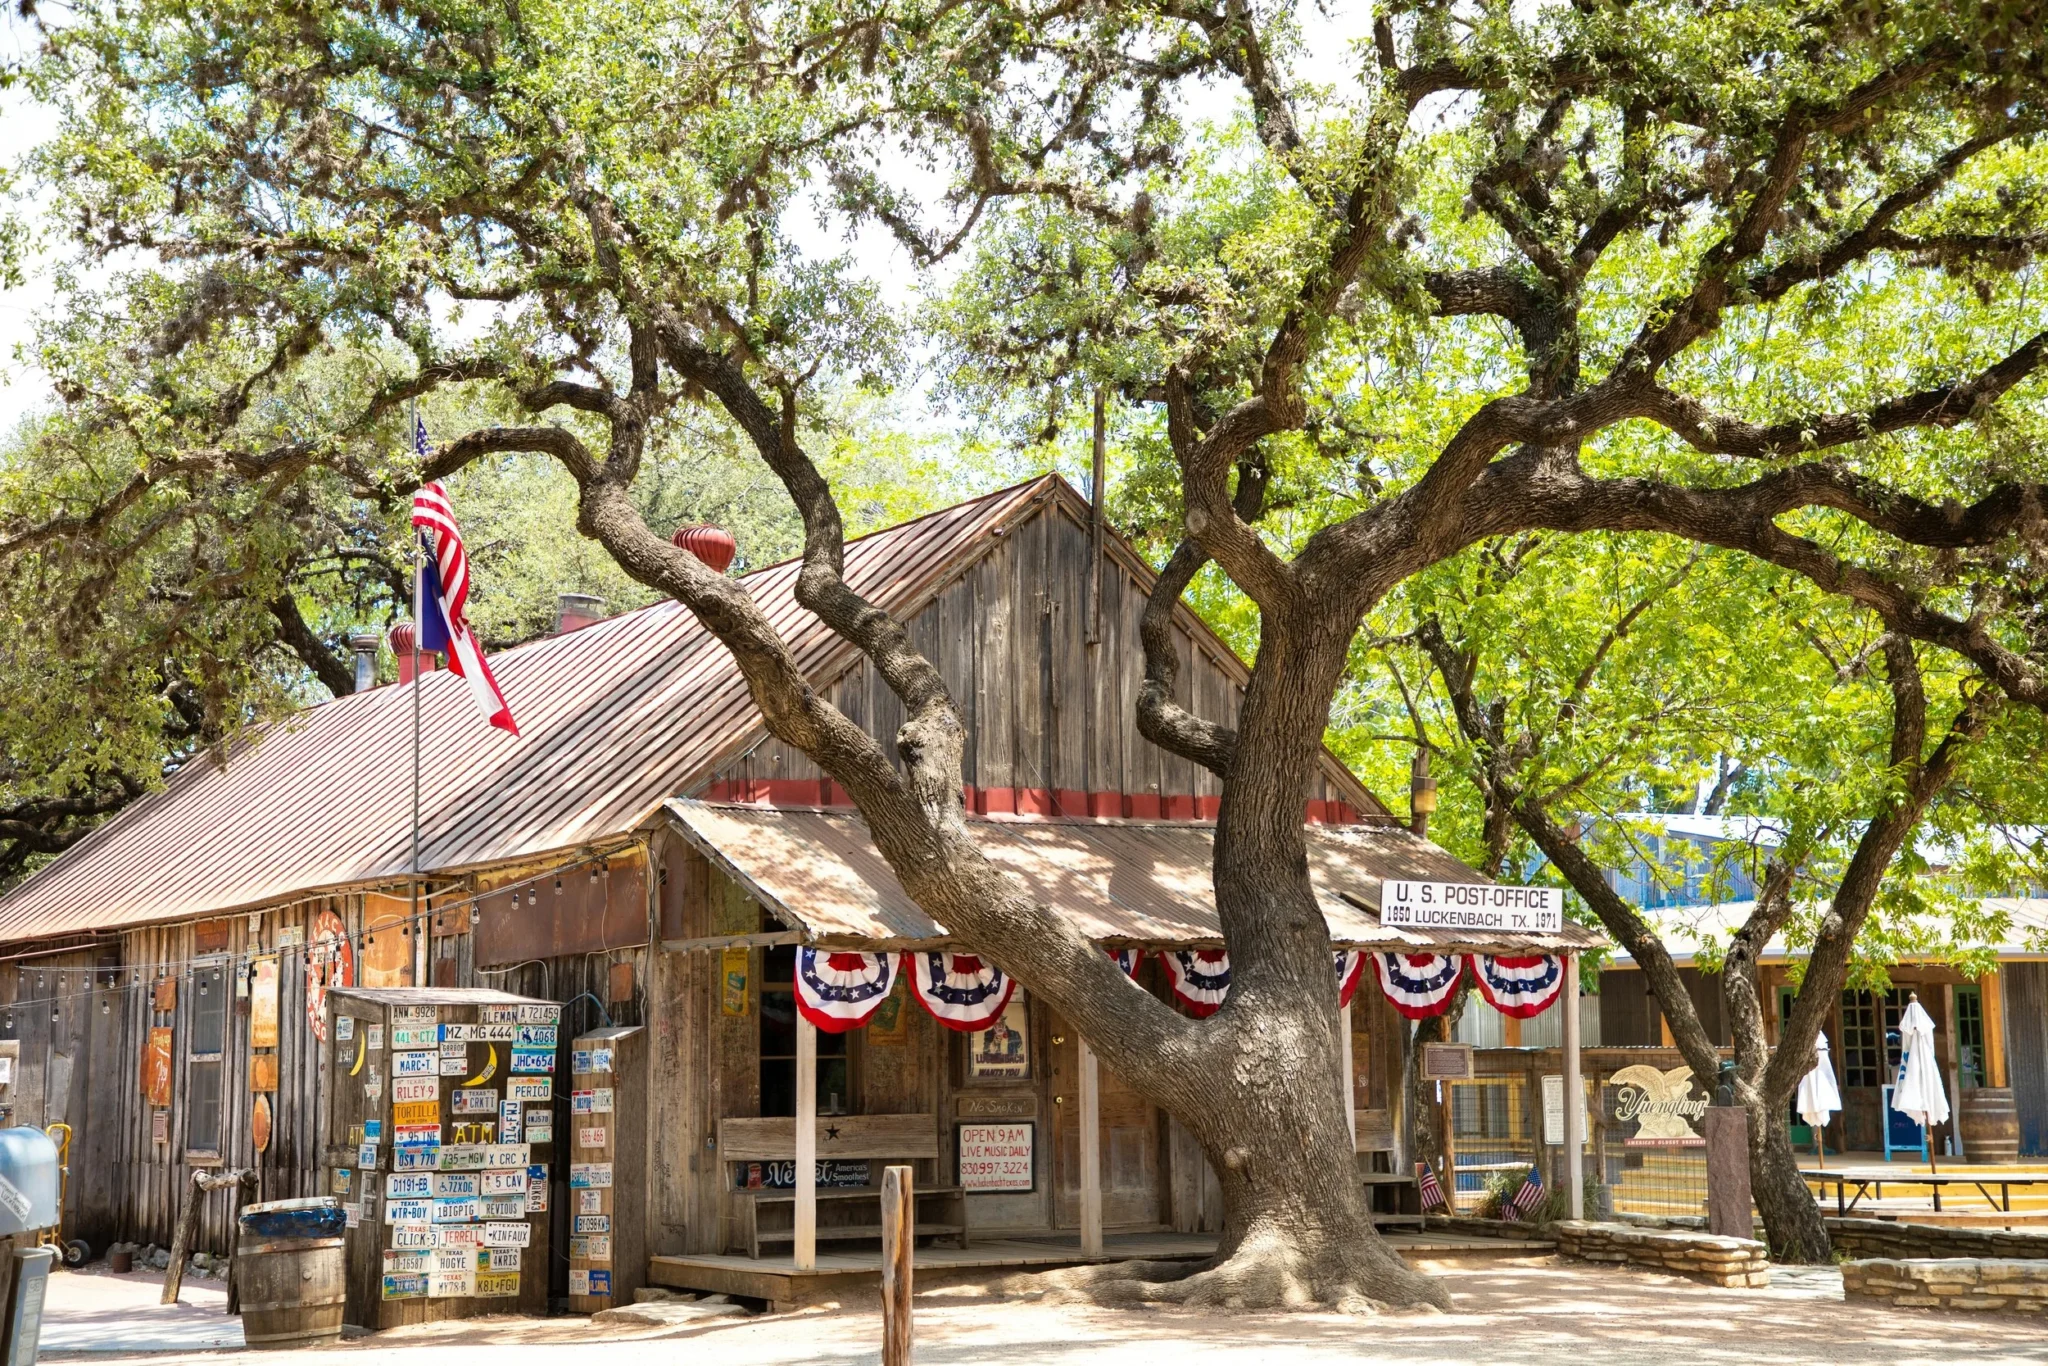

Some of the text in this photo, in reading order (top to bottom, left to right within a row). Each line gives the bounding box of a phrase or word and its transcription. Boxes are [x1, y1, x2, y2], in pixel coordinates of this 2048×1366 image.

[1396, 883, 1549, 909] U. S. POST-OFFICE
[1387, 905, 1557, 928] 1850 LUCKENBACH TX. 1971
[393, 1006, 436, 1019] ANW 9928
[482, 1012, 518, 1024] ALEMAN
[528, 1006, 559, 1020] 721459
[395, 1032, 411, 1044] 441
[420, 1030, 436, 1042] CTZ
[446, 1026, 512, 1039] MZ MG 444
[533, 1030, 555, 1043] 4068
[514, 1056, 553, 1067] JHC 654
[976, 1053, 1025, 1064] LUCKENBACH
[978, 1068, 1021, 1077] WANTS YOU
[515, 1086, 549, 1098] PERICO
[470, 1096, 494, 1108] CRKTT
[970, 1101, 985, 1112] No
[1615, 1086, 1710, 1122] Yuengling
[396, 1104, 438, 1118] TORTILLA
[454, 1124, 493, 1144] ATM
[963, 1128, 1025, 1142] OPEN 9 AM
[961, 1146, 1031, 1158] LIVE MUSIC DAILY
[420, 1154, 436, 1166] 770
[500, 1154, 516, 1164] CRC
[762, 1160, 833, 1186] Veet
[832, 1172, 870, 1181] Smoothest
[506, 1175, 522, 1188] CAV
[444, 1230, 481, 1244] TERRELL
[440, 1257, 467, 1269] HOGYE
[494, 1254, 518, 1266] 4KRIS
[478, 1278, 518, 1292] K81 FGU
